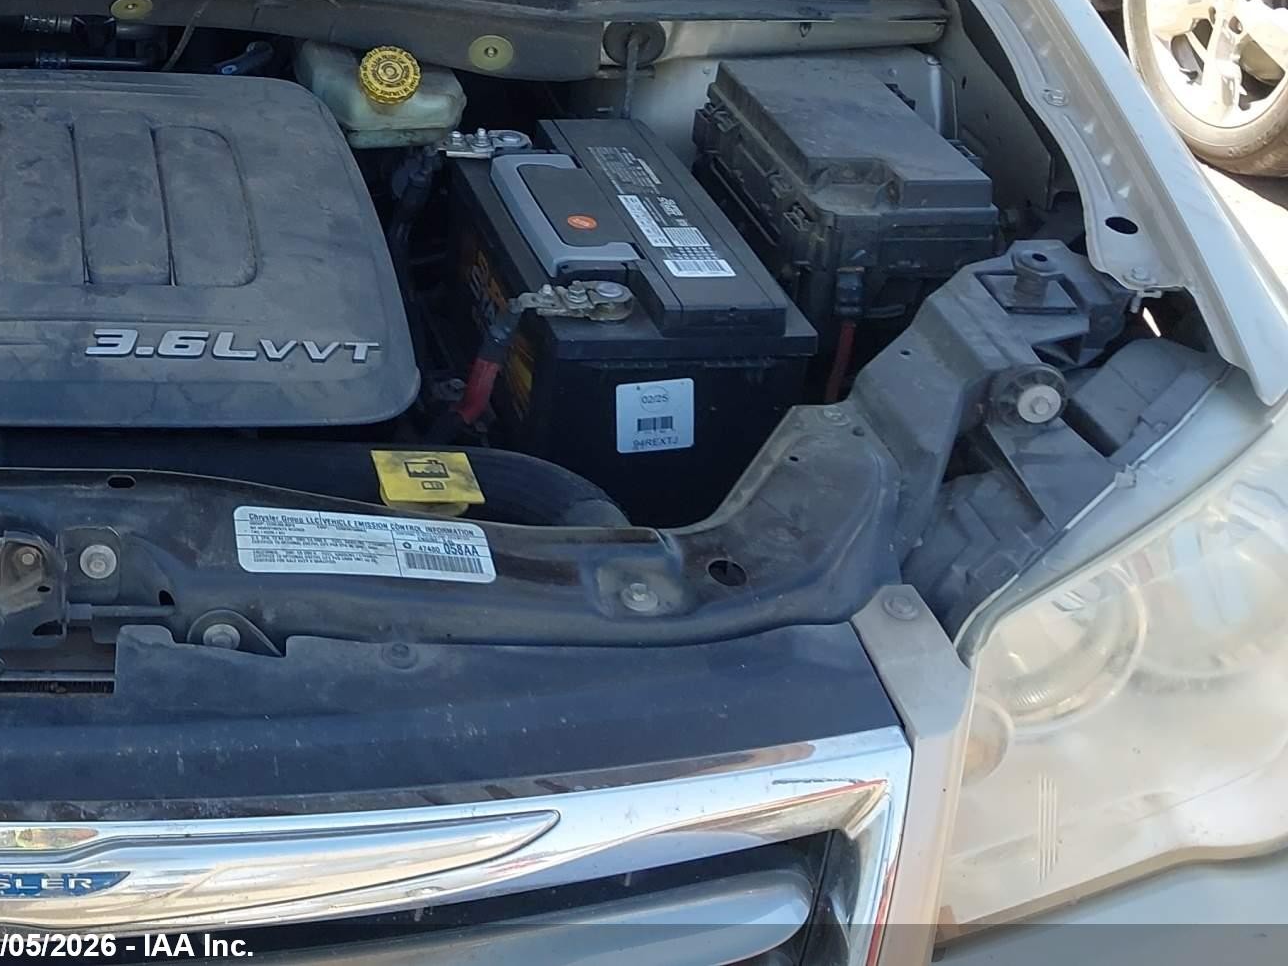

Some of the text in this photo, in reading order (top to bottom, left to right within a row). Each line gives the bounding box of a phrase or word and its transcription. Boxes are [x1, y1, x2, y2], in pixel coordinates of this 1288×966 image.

[641, 394, 669, 404] 02/25
[248, 513, 279, 523] Chrysler
[281, 514, 304, 525] Group
[306, 516, 320, 525] LLC
[322, 517, 351, 527] VEHICLE
[353, 520, 388, 530] EMISSION
[390, 522, 423, 532] CONTROL
[425, 525, 474, 537] INFORMATION
[443, 542, 480, 556] 058AA
